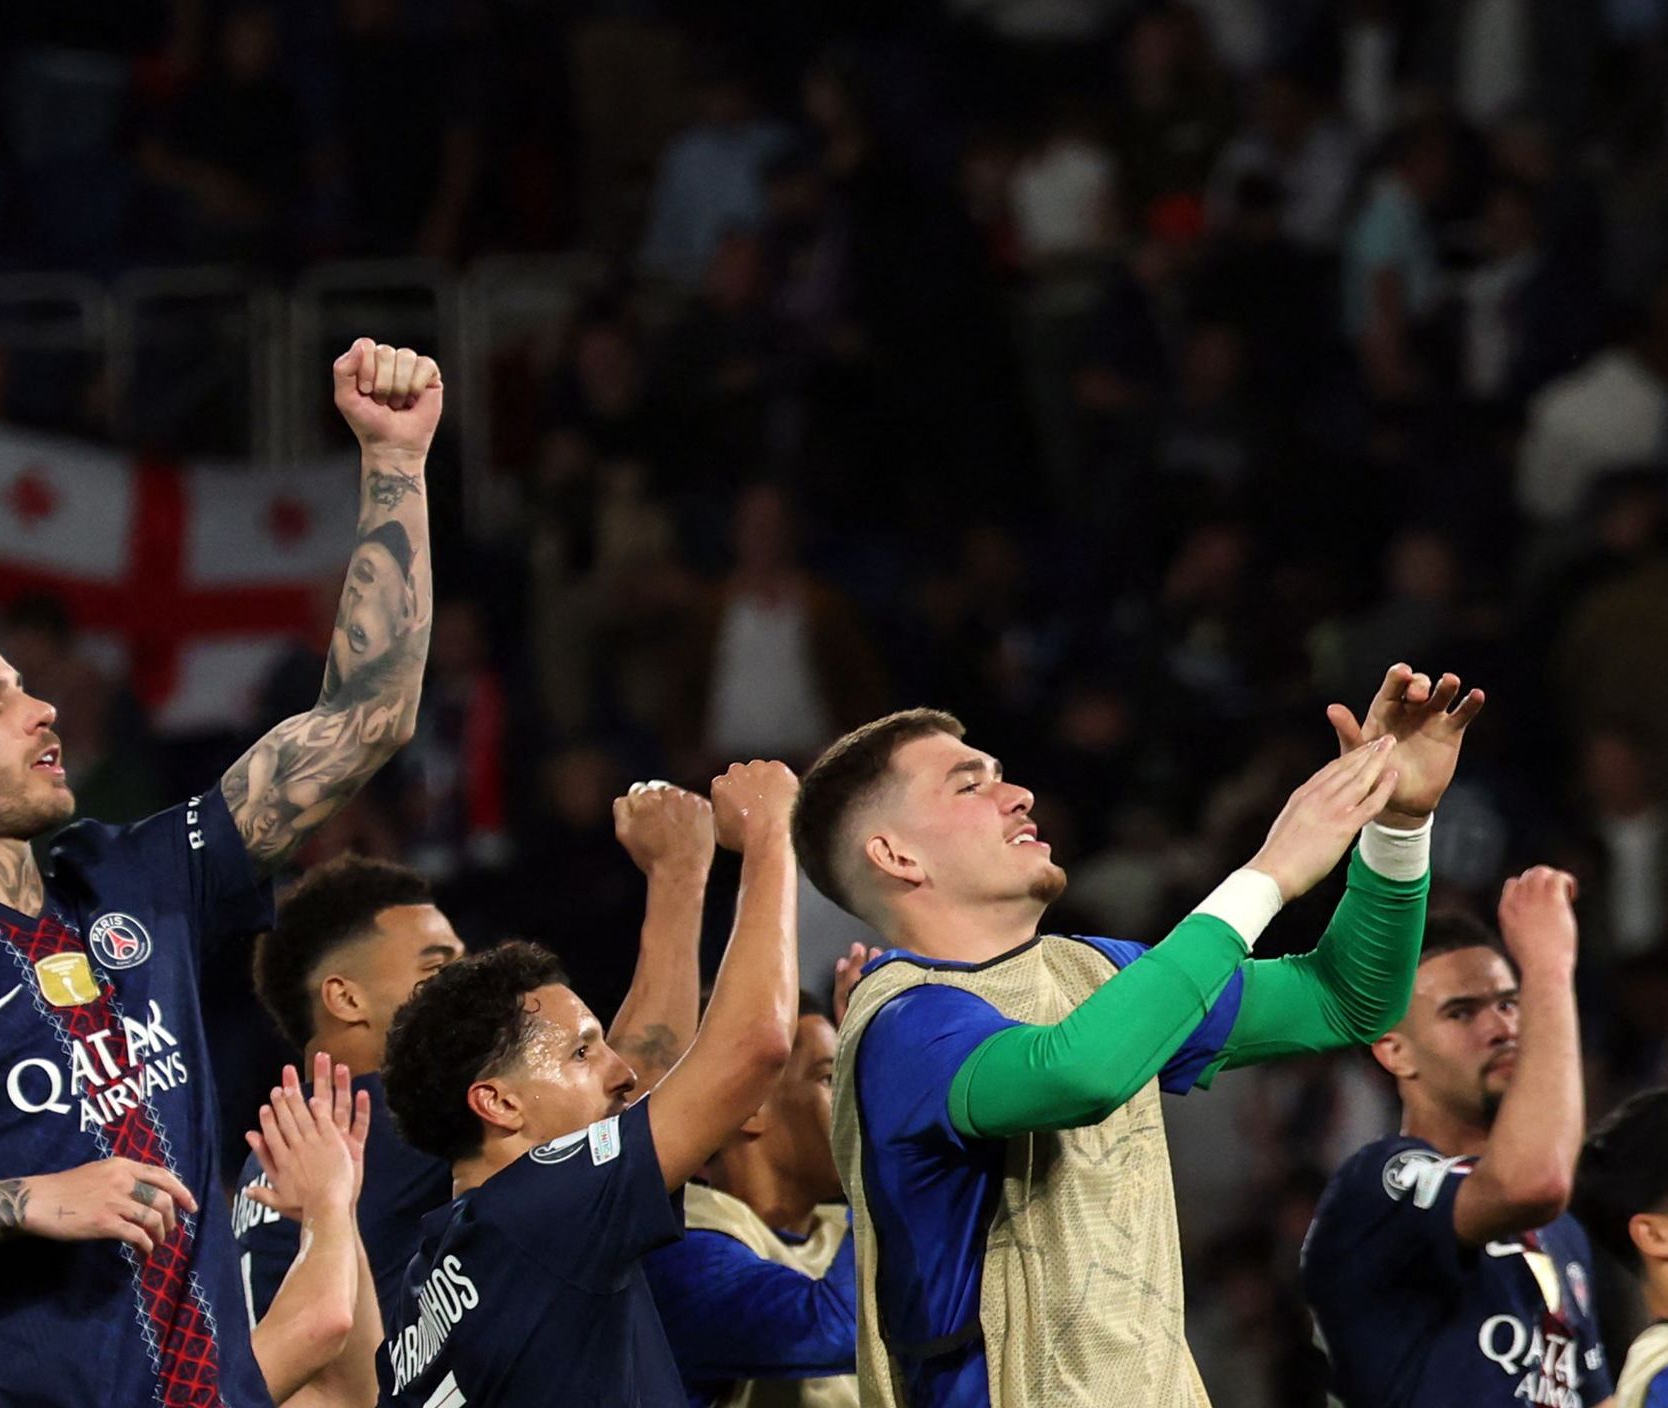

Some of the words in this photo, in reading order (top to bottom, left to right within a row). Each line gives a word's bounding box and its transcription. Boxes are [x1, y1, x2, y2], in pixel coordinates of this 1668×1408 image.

[92, 916, 124, 942] PARIS
[6, 999, 178, 1115] QATAR
[79, 1051, 188, 1132] AIRWAYS
